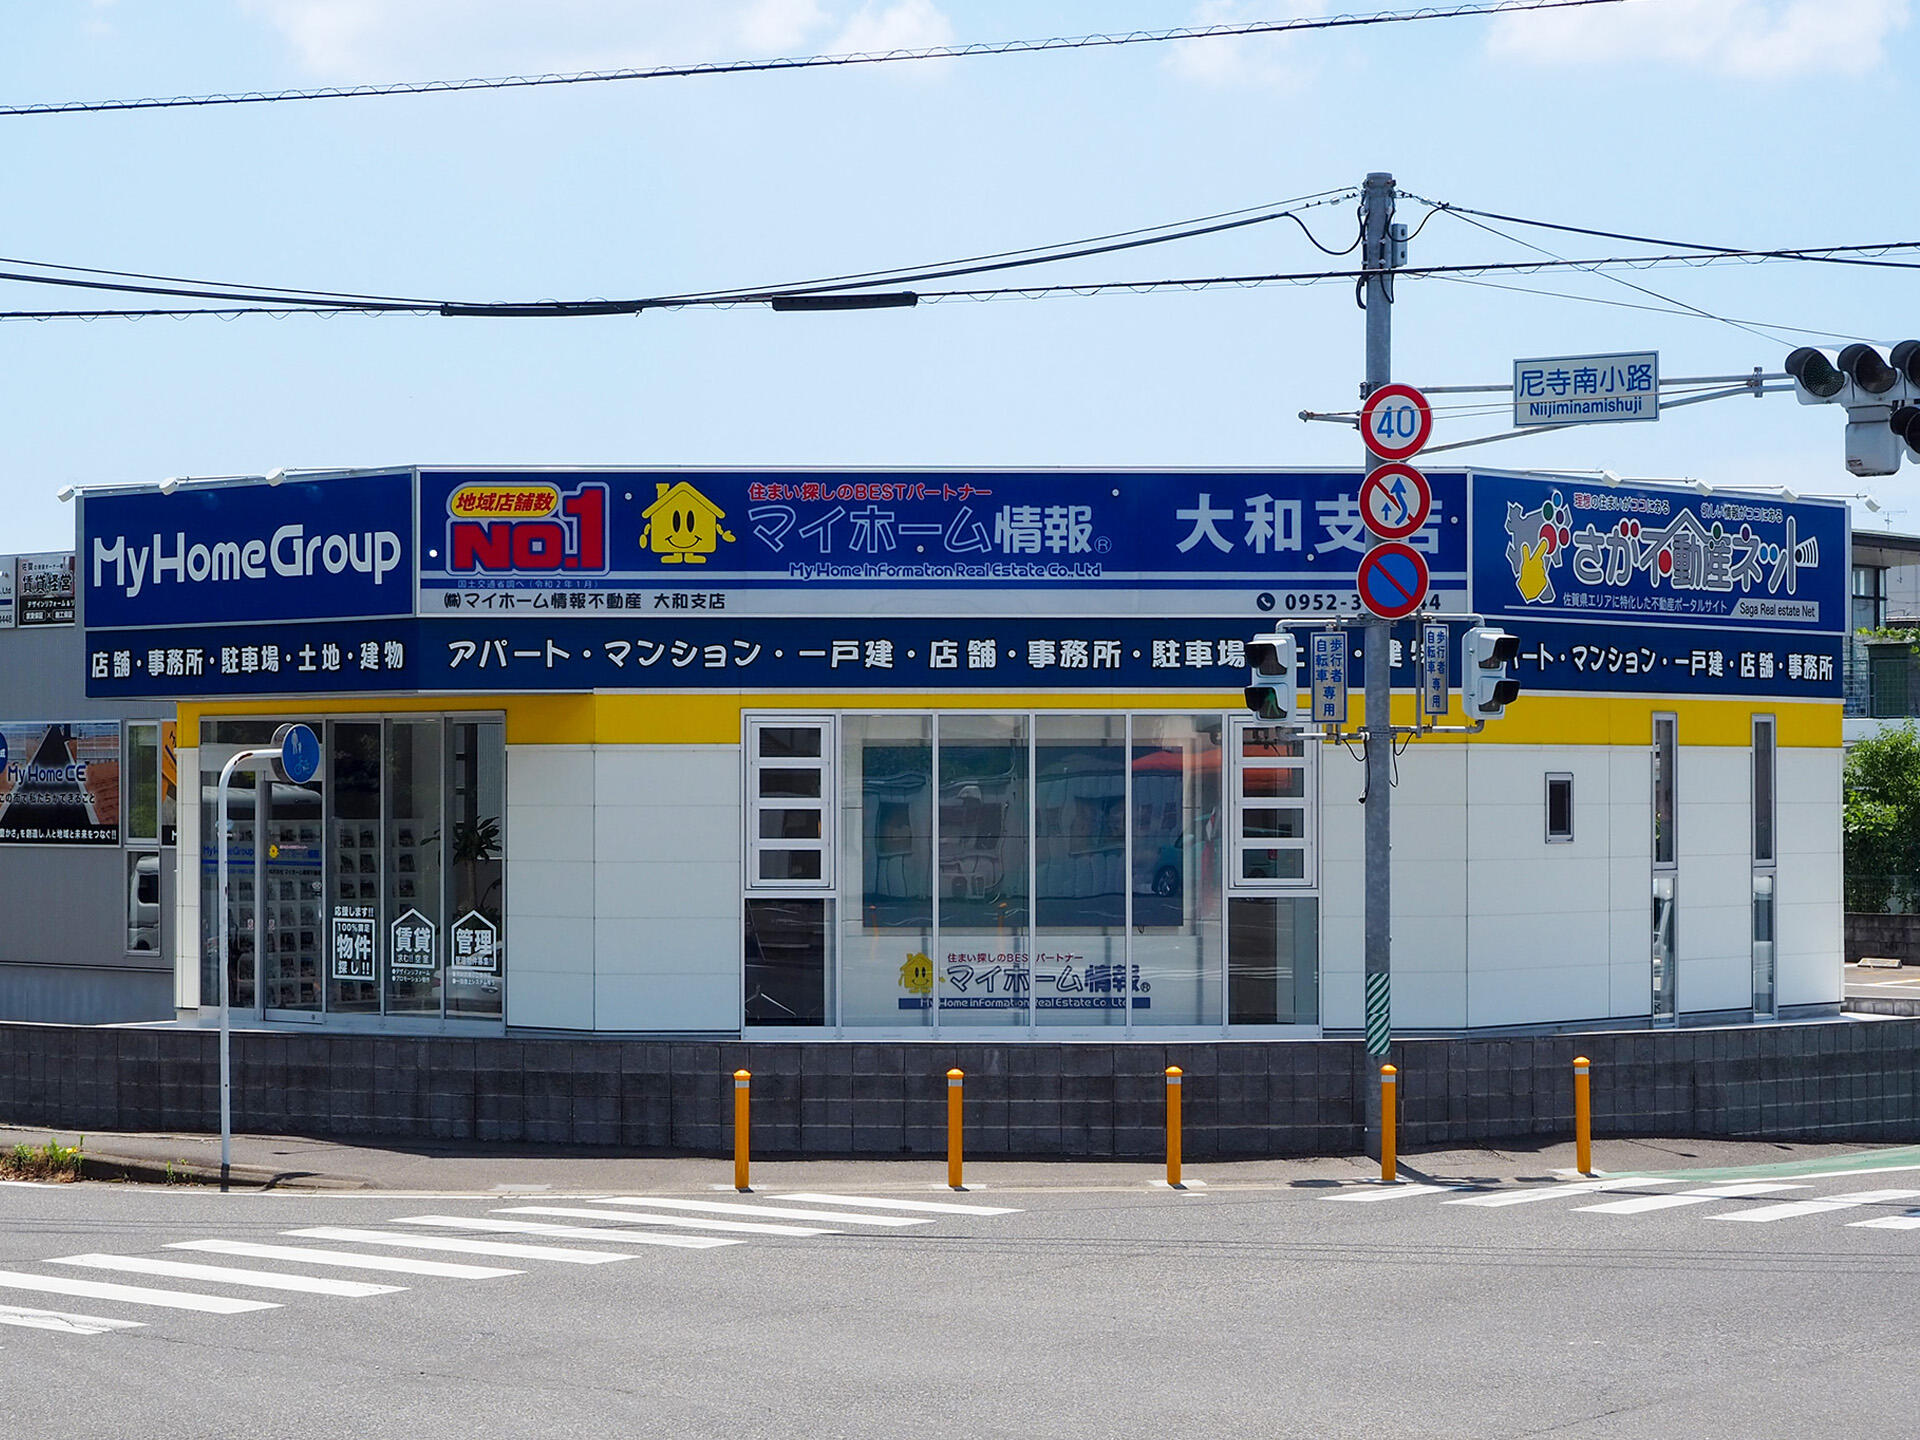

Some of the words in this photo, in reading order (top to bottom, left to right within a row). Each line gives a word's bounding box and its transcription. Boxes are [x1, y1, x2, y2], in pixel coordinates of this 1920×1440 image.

[1519, 364, 1652, 397] 尼寺南小路
[1530, 397, 1642, 418] Niijiminamishuji
[1376, 405, 1416, 439] 40
[748, 483, 992, 501] 住まい探しのBESTパートナー
[456, 493, 554, 513] 地域店舗数
[23, 573, 71, 592] 賃貸経営
[654, 592, 726, 610] 大和支店
[1563, 592, 1727, 613] 佐賀県エリアに特化した不動産ポータルサイト
[1740, 602, 1758, 618] Saga
[1760, 603, 1776, 616] Real
[1778, 604, 1800, 617] estate
[1802, 605, 1816, 618] Net
[1315, 638, 1329, 682] 自転車
[1330, 637, 1343, 682] 歩行者
[1323, 685, 1337, 717] 専用
[8, 765, 25, 785] My
[28, 765, 63, 782] Home
[337, 933, 371, 960] 物件
[395, 926, 431, 953] 賃貸
[455, 928, 493, 955] 管理
[947, 953, 1083, 963] 住まい探しのBESパートナー
